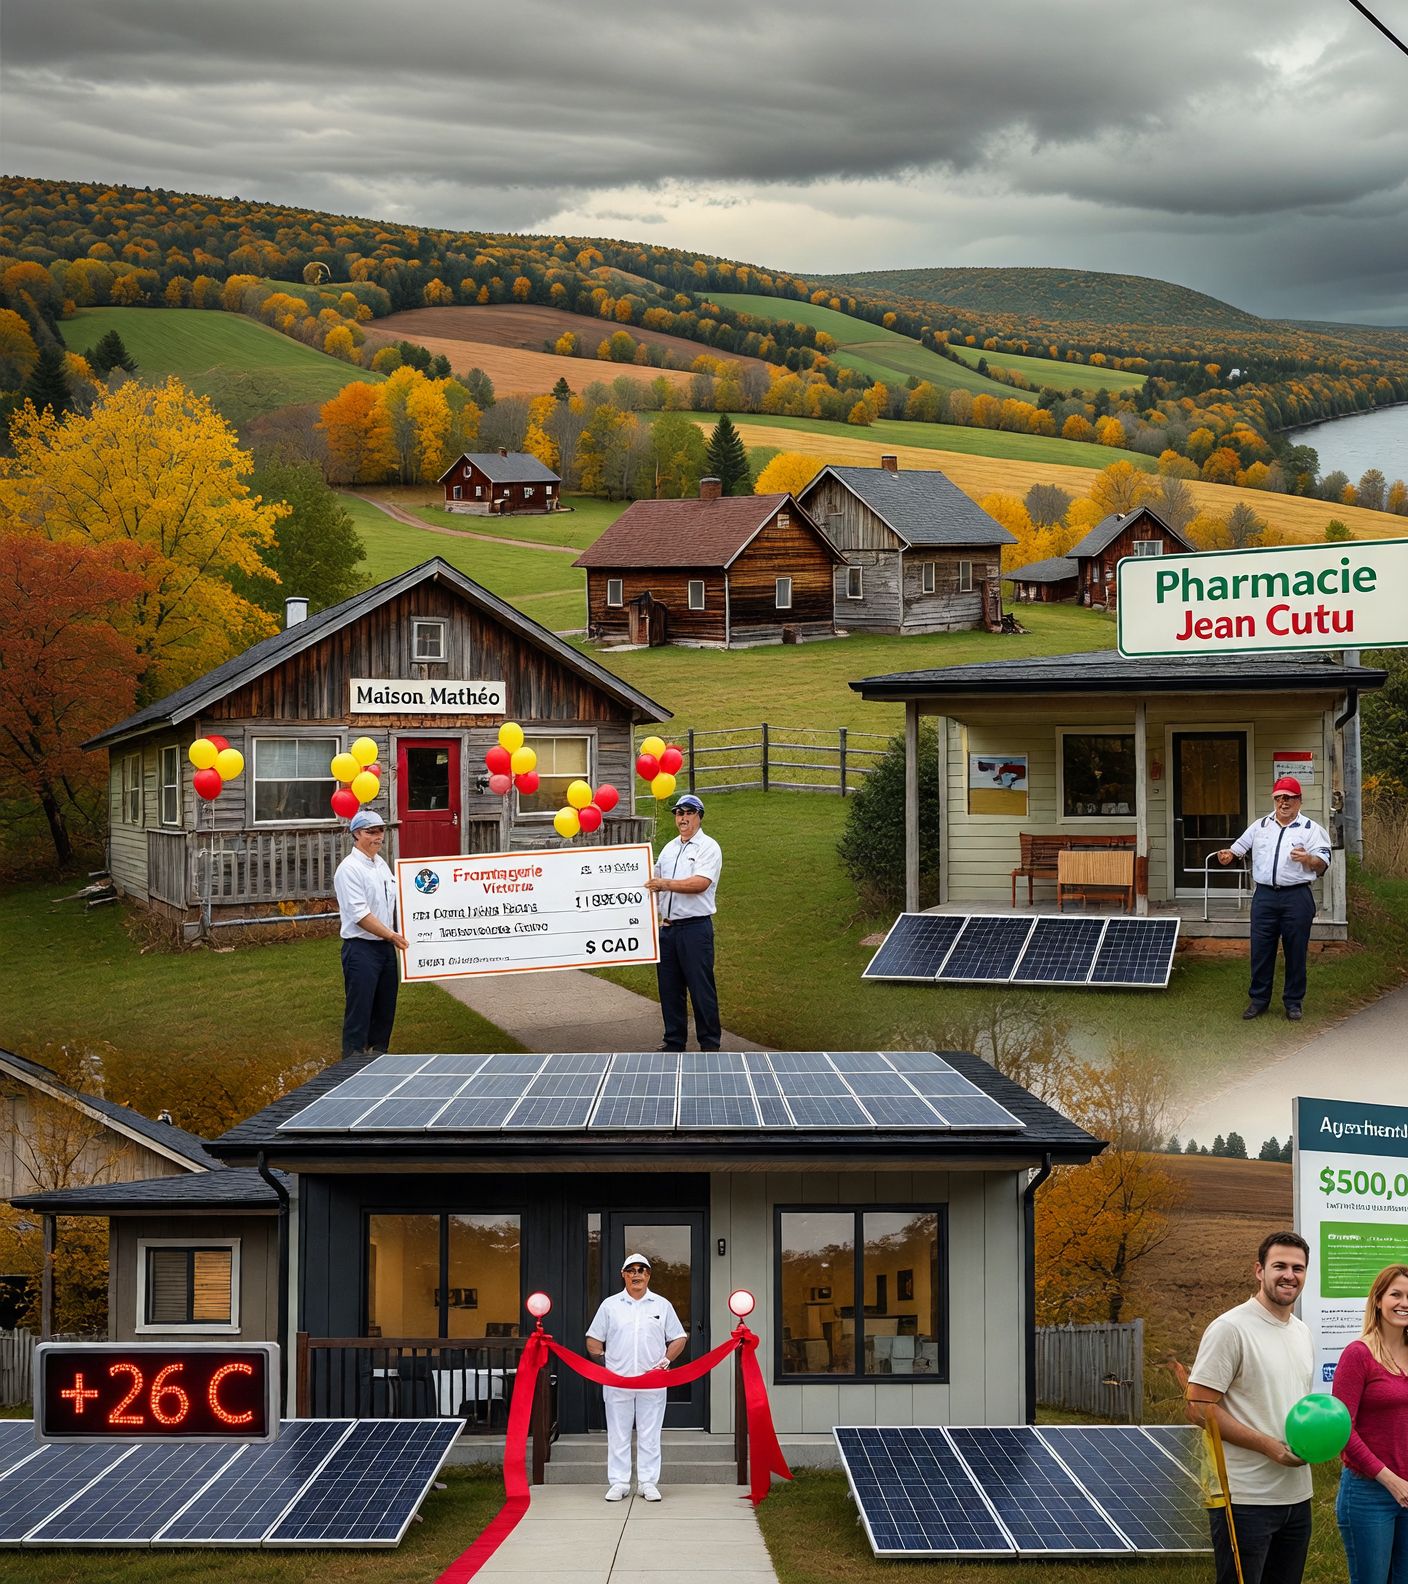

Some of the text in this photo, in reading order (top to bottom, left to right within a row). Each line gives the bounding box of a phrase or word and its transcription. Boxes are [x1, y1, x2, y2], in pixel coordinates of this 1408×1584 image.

[1156, 557, 1377, 604] Pharmacie
[1176, 604, 1354, 641] Jean Cutu
[357, 686, 500, 706] Maison Mathéo
[585, 937, 639, 954] $ CAD
[61, 1363, 254, 1424] +26 C
